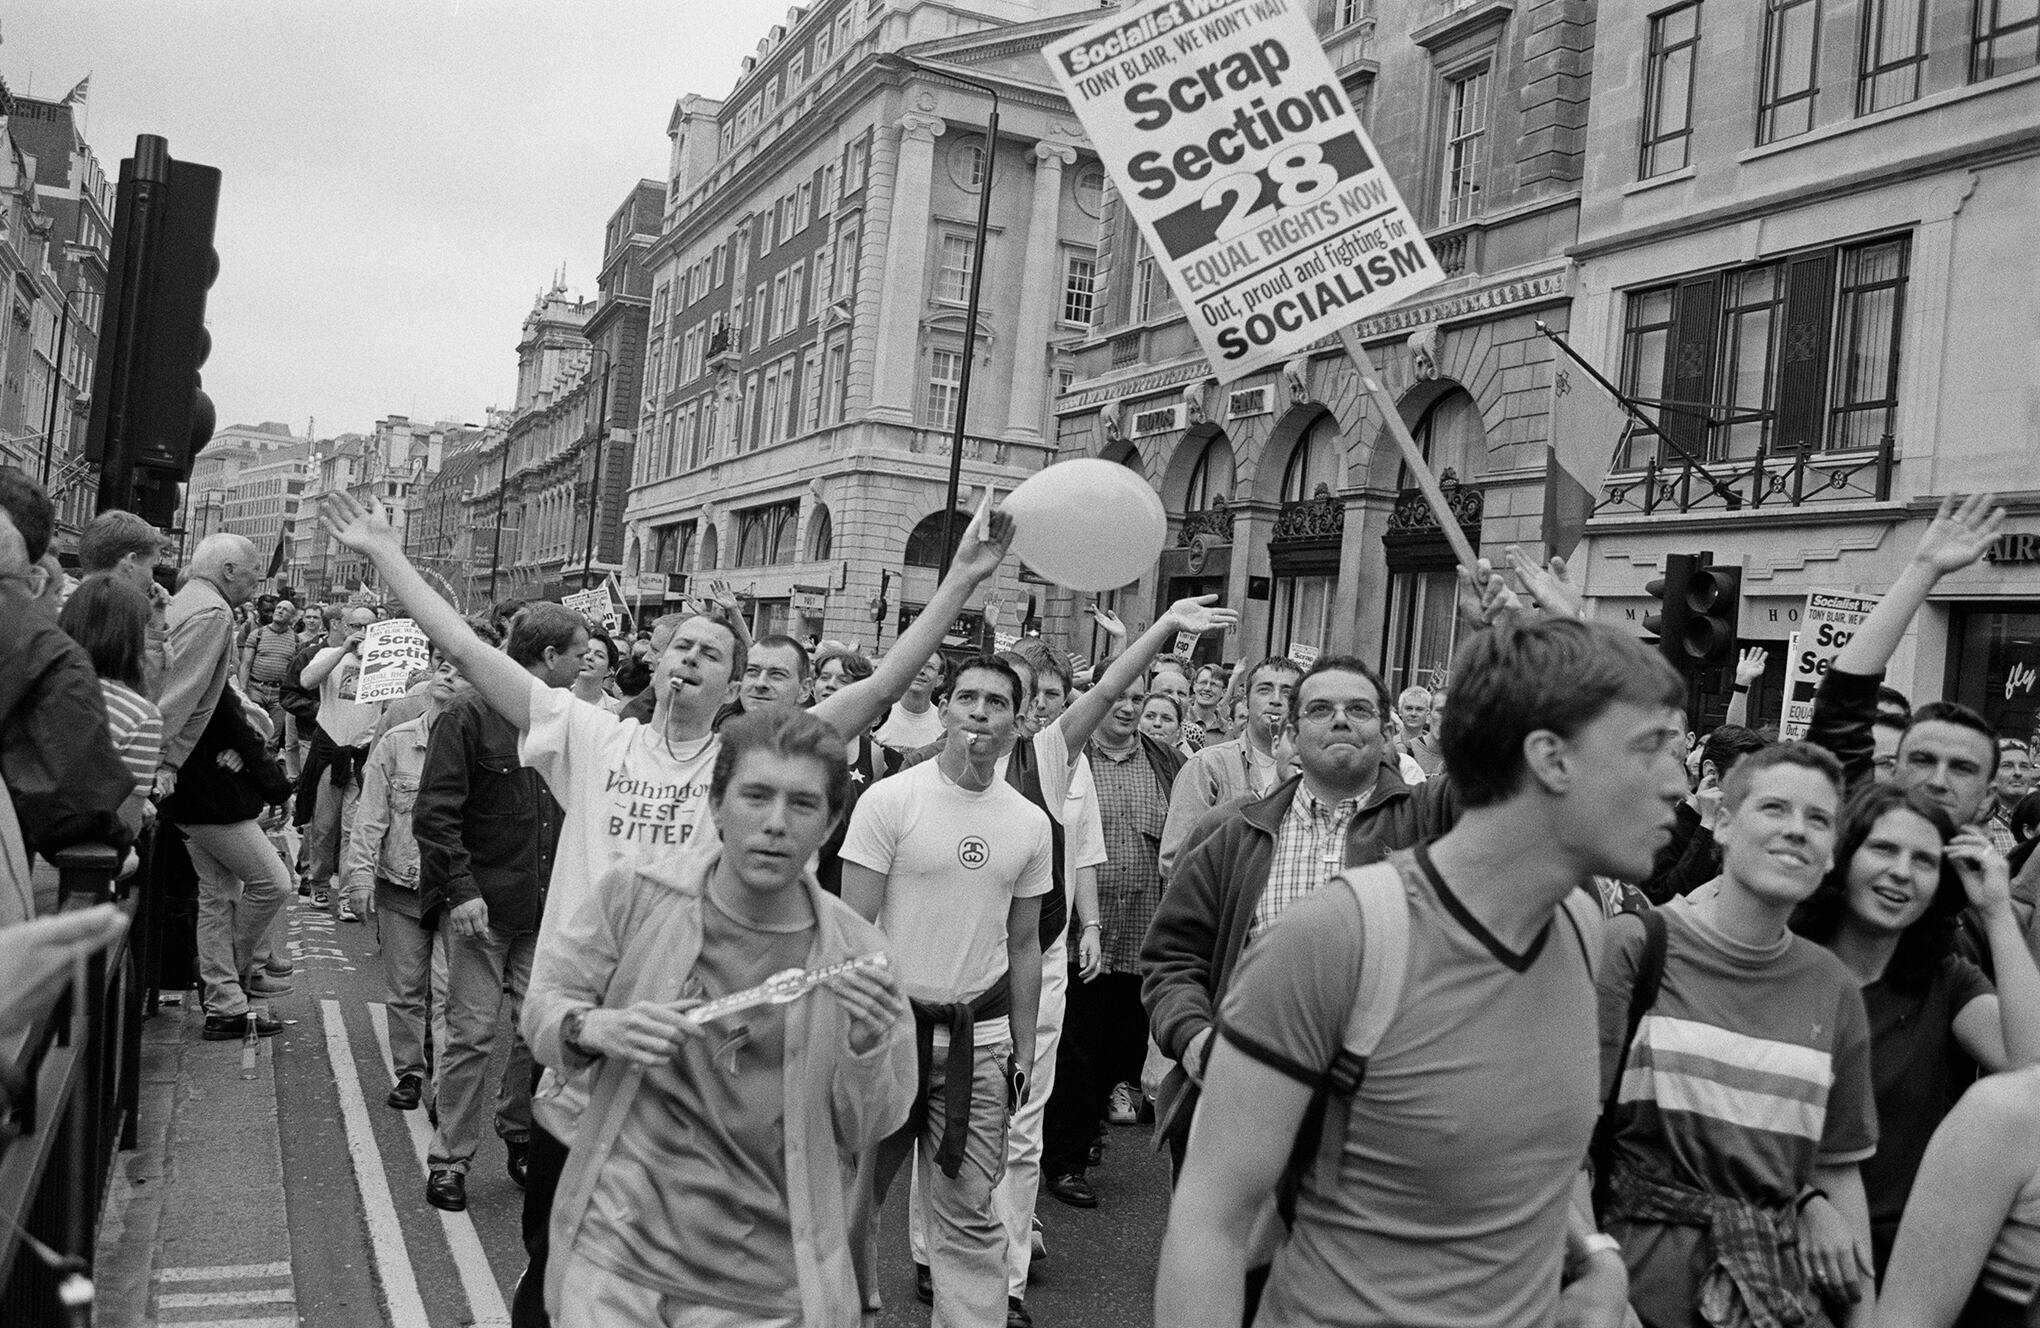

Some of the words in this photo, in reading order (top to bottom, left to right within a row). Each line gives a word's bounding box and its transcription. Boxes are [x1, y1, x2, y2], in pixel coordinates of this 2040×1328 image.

[1069, 3, 1184, 72] Socialist
[1075, 69, 1120, 101] TONY
[1120, 46, 1177, 81] BLAIR,
[1174, 27, 1204, 55] WE
[1201, 8, 1252, 44] WON'T
[1124, 38, 1290, 131] Scrap
[1127, 84, 1345, 200] Section
[1200, 141, 1339, 244] 28
[1180, 241, 1259, 293] EQUAL
[1257, 200, 1340, 255] RIGHTS
[1338, 177, 1390, 218] NOW
[1200, 294, 1243, 327] Out,
[1242, 266, 1294, 312] proud
[1294, 248, 1327, 283] and
[1324, 227, 1389, 267] fighting
[1384, 216, 1408, 240] for
[1216, 241, 1427, 360] SOCIALISM
[1809, 609, 1825, 621] TONY
[1812, 595, 1860, 610] Socialist
[367, 647, 429, 662] Sectio
[378, 635, 429, 650] Scra
[1816, 623, 1854, 648] Scr
[361, 687, 404, 699] SOCIA
[2005, 662, 2036, 700] fly
[1790, 706, 1814, 720] EQUA
[609, 815, 694, 844] BITTER
